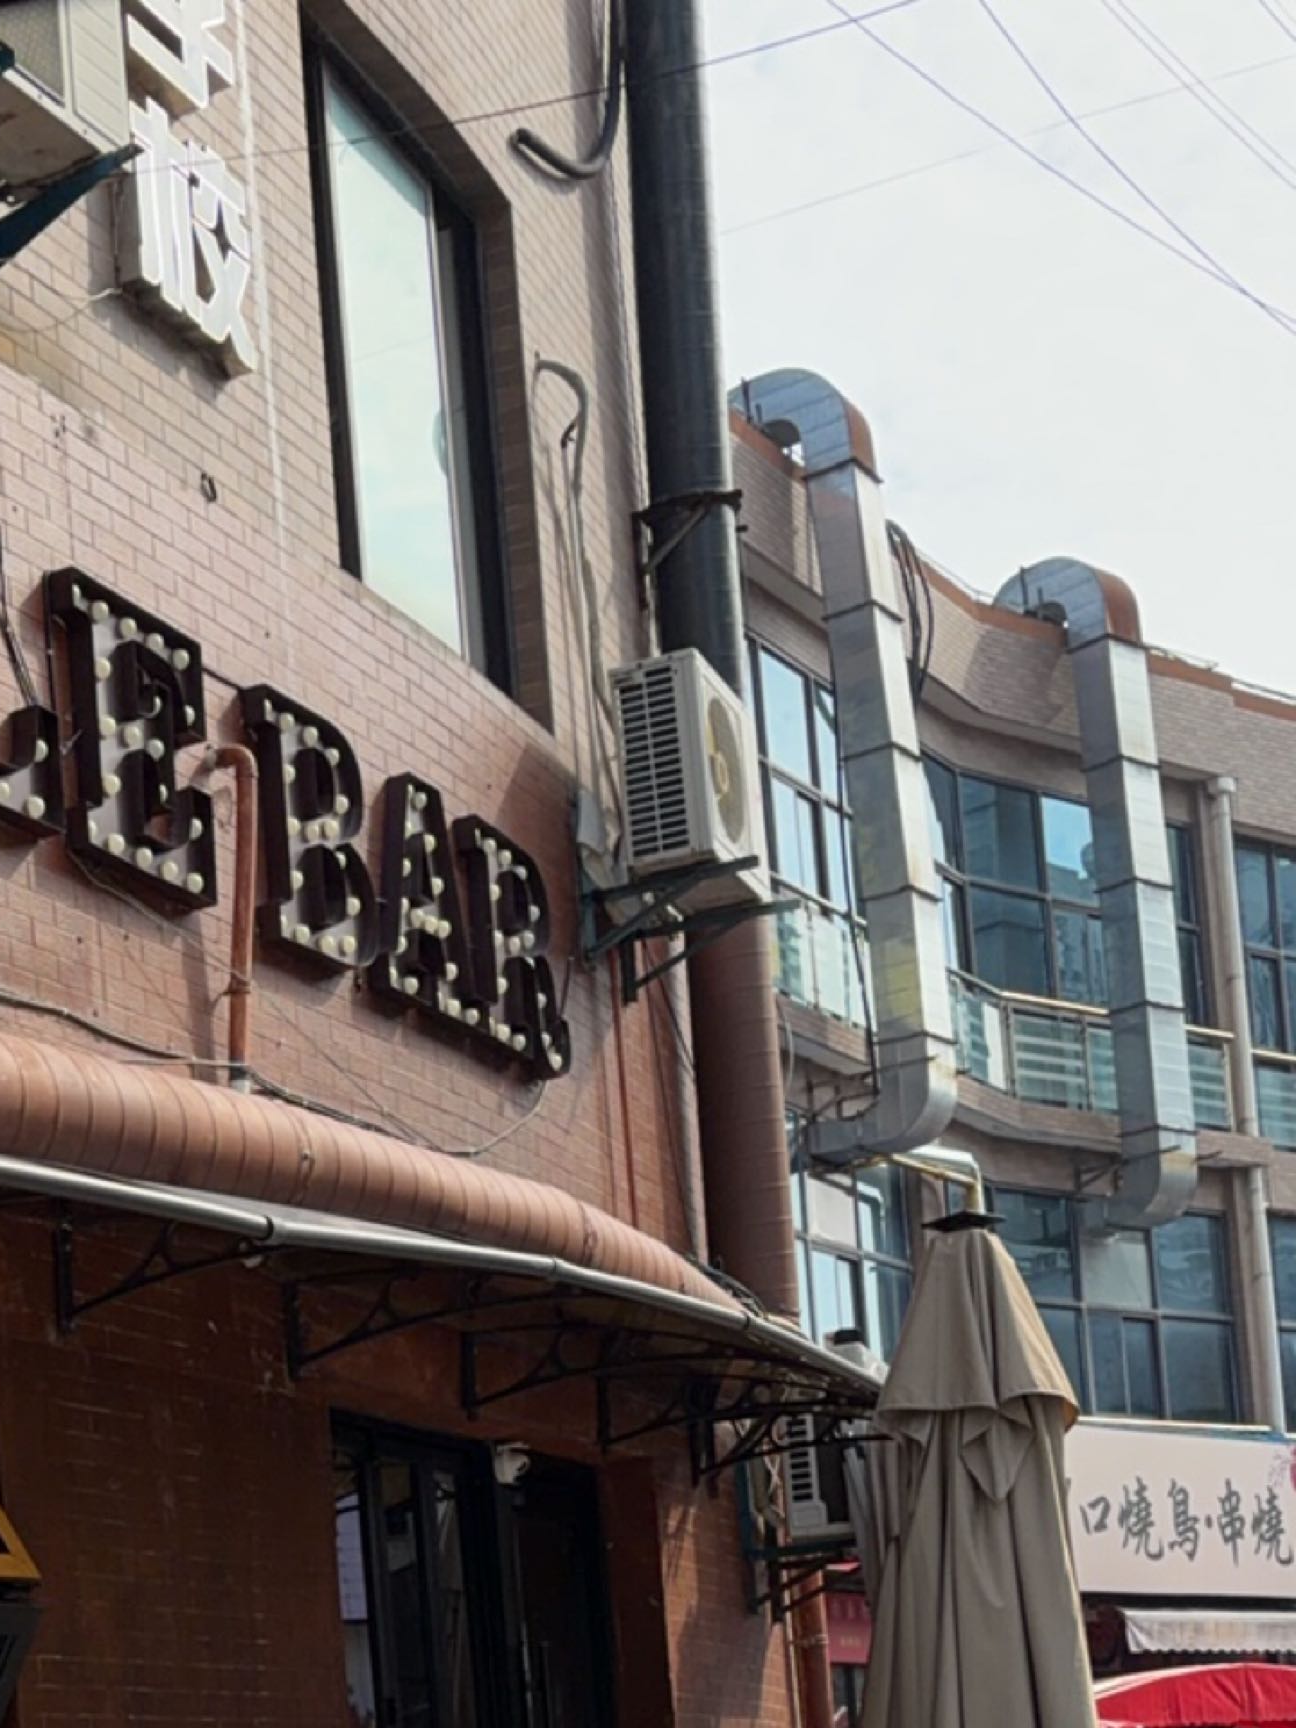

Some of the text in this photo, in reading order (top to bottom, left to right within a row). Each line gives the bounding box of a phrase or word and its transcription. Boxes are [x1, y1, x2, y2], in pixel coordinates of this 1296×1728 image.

[242, 683, 572, 1080] BAR
[1065, 1475, 1295, 1568] 口燒鳥·串燒
